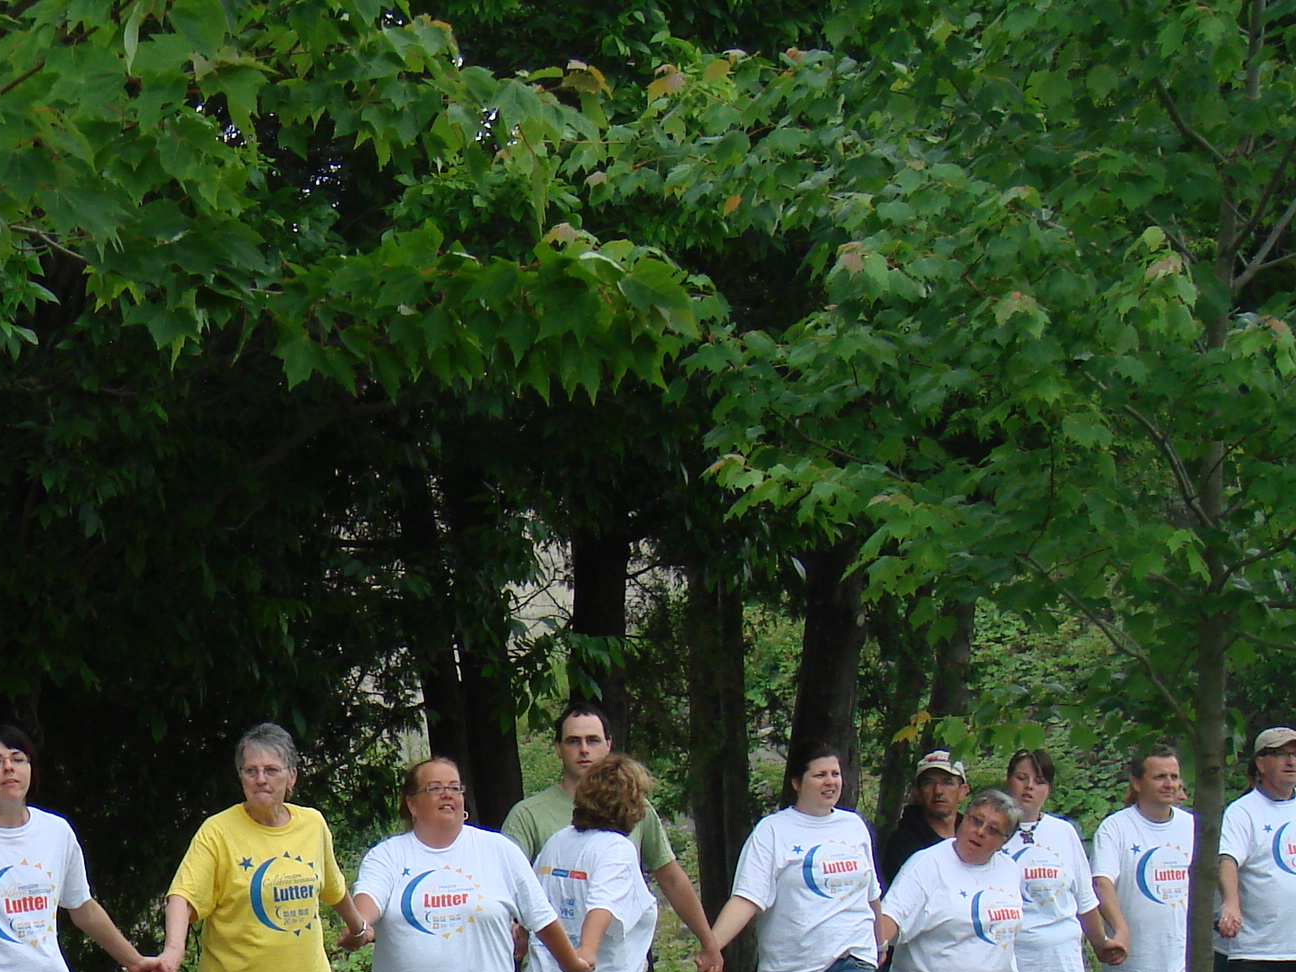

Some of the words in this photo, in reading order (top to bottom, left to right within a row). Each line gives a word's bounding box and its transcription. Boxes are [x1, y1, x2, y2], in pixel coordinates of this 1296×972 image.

[822, 861, 858, 875] Lutter
[1024, 867, 1059, 880] Lutter
[1155, 869, 1186, 881] Lutter
[273, 885, 314, 902] Lutter
[424, 893, 468, 908] Lutter
[5, 895, 47, 914] Lutter
[988, 908, 1020, 921] Lutter
